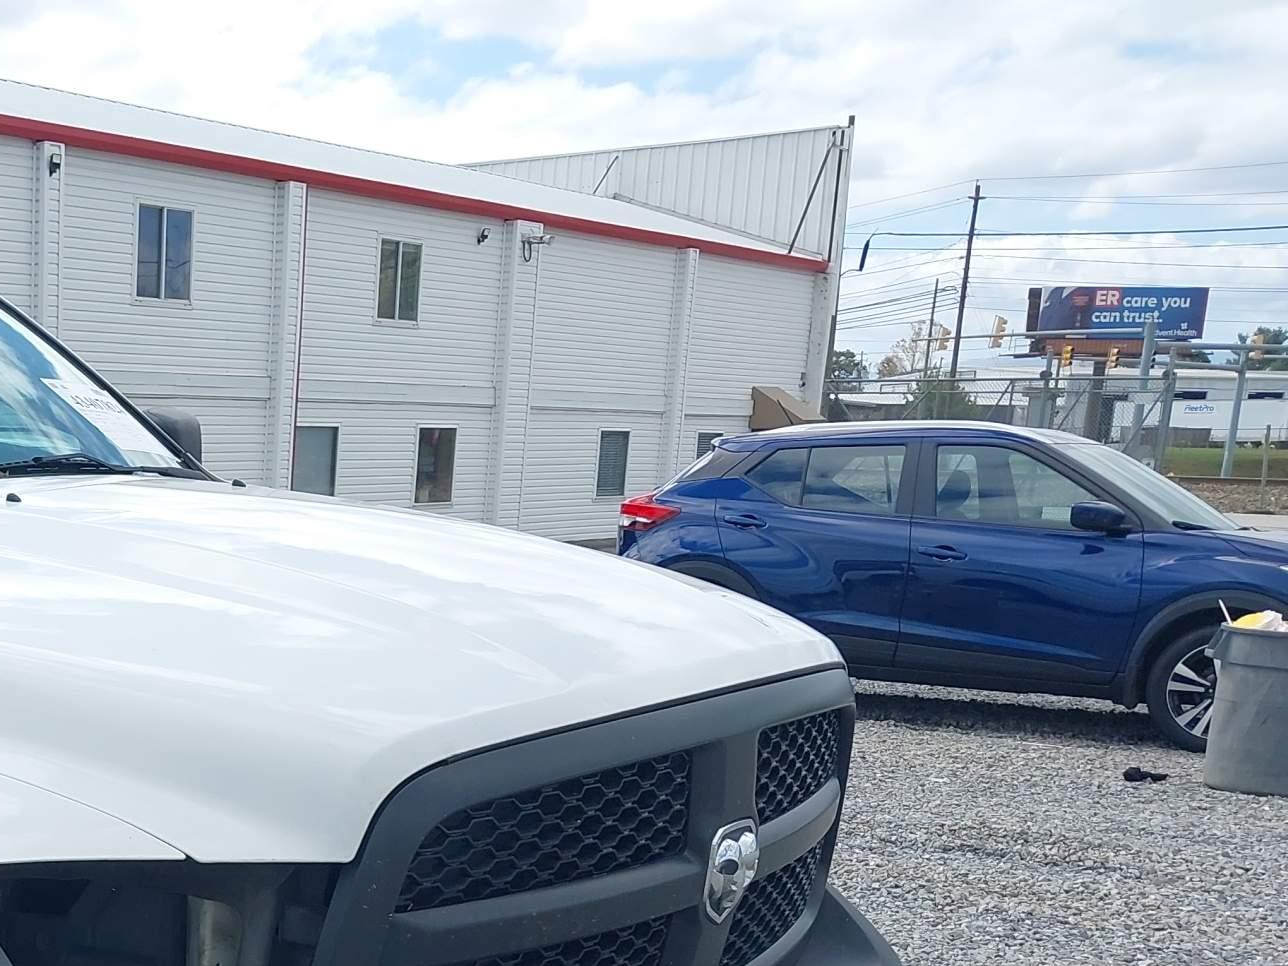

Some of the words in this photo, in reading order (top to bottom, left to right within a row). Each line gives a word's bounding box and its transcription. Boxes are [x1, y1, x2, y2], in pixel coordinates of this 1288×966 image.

[1095, 290, 1120, 306] ER
[1122, 296, 1158, 308] care
[1162, 296, 1191, 311] you
[1091, 310, 1120, 323] can
[1123, 309, 1163, 323] trust.
